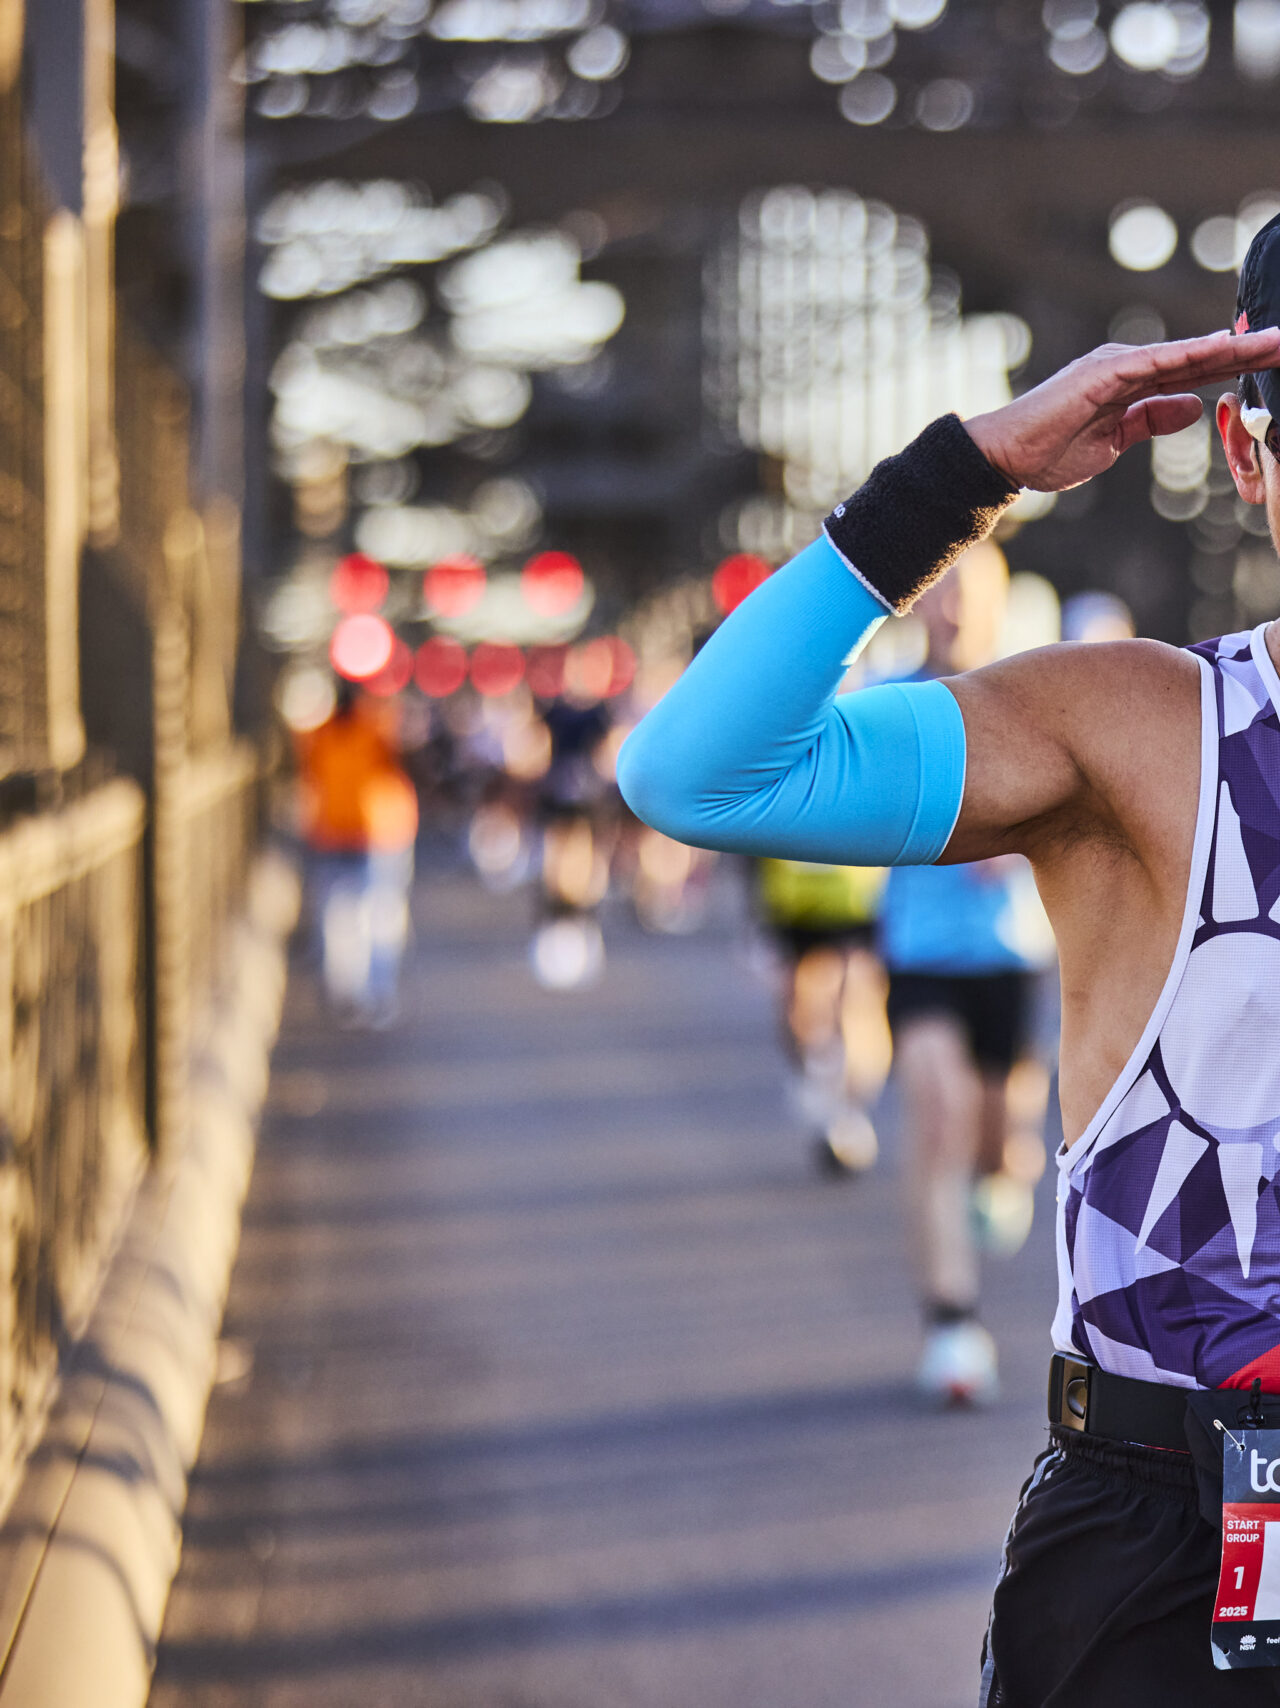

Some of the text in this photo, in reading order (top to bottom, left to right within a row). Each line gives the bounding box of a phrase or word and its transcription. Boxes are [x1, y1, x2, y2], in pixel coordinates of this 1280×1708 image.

[1227, 1520, 1260, 1530] START
[1226, 1533, 1260, 1543] GROUP
[1233, 1566, 1245, 1590] 1
[1218, 1606, 1248, 1618] 2025
[1266, 1636, 1280, 1644] feel
[1239, 1643, 1256, 1651] NSW
